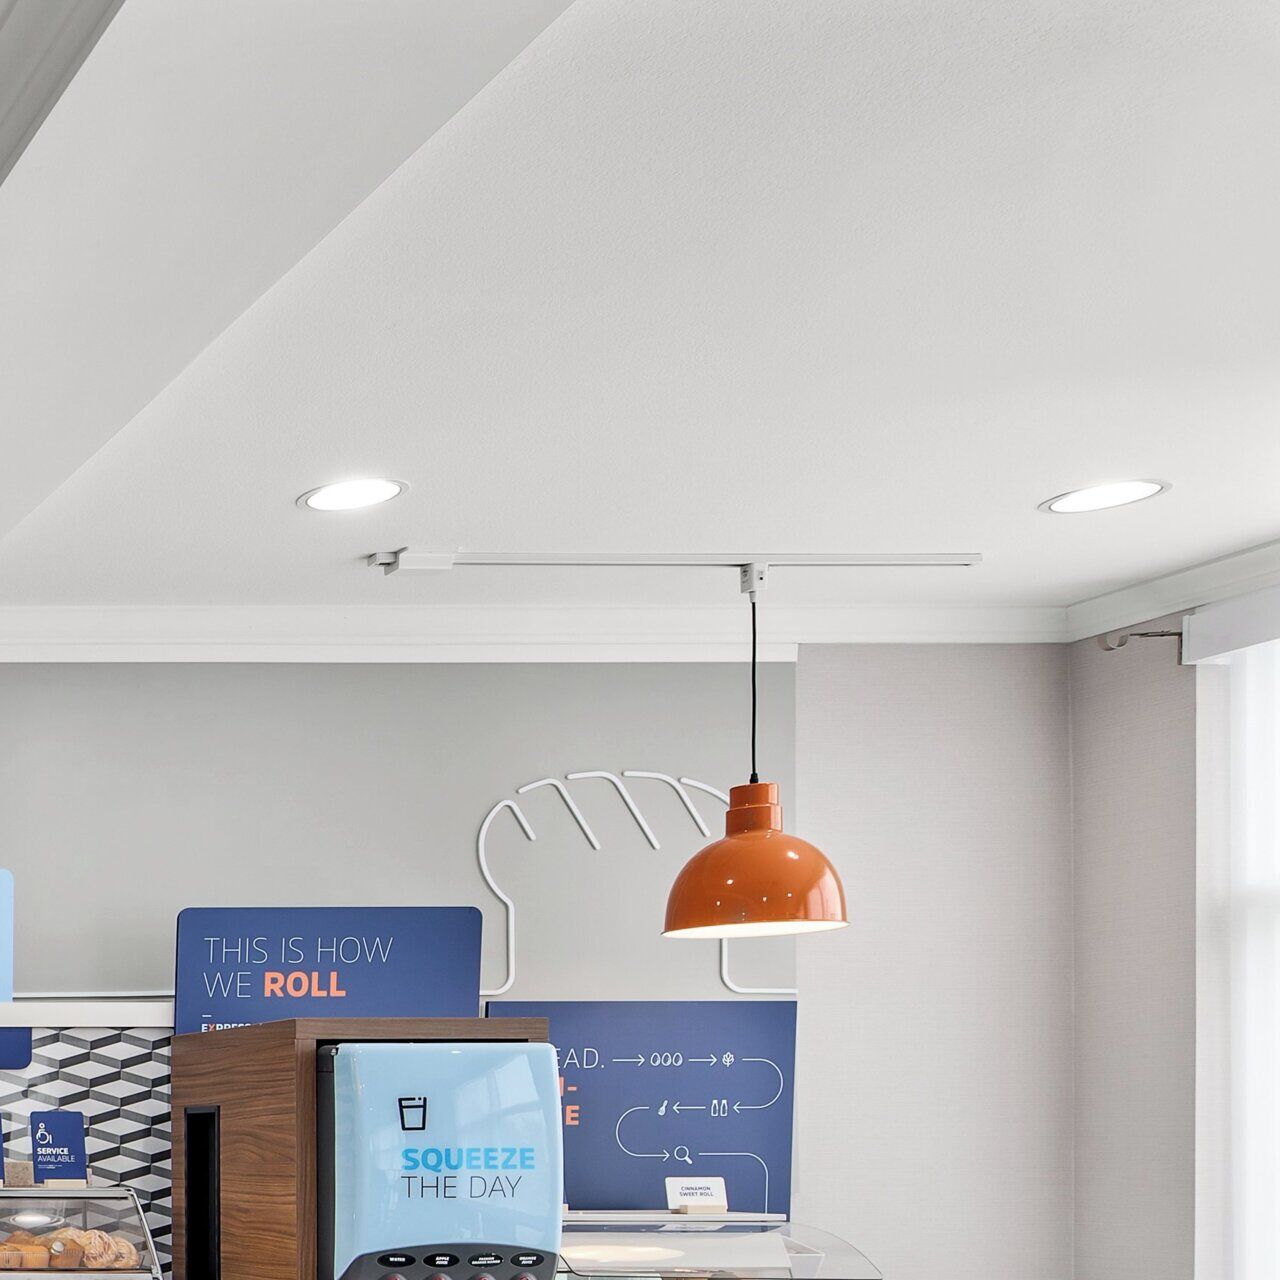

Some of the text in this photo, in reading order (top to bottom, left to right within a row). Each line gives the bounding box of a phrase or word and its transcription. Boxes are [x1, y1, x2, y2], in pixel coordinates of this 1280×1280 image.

[204, 937, 394, 964] THIS IS HOW
[203, 971, 347, 998] WE ROLL
[37, 1147, 69, 1155] SERVICE
[37, 1155, 76, 1163] AVAILABLE
[400, 1146, 536, 1171] SQUEEZE
[400, 1175, 523, 1199] THE DAY
